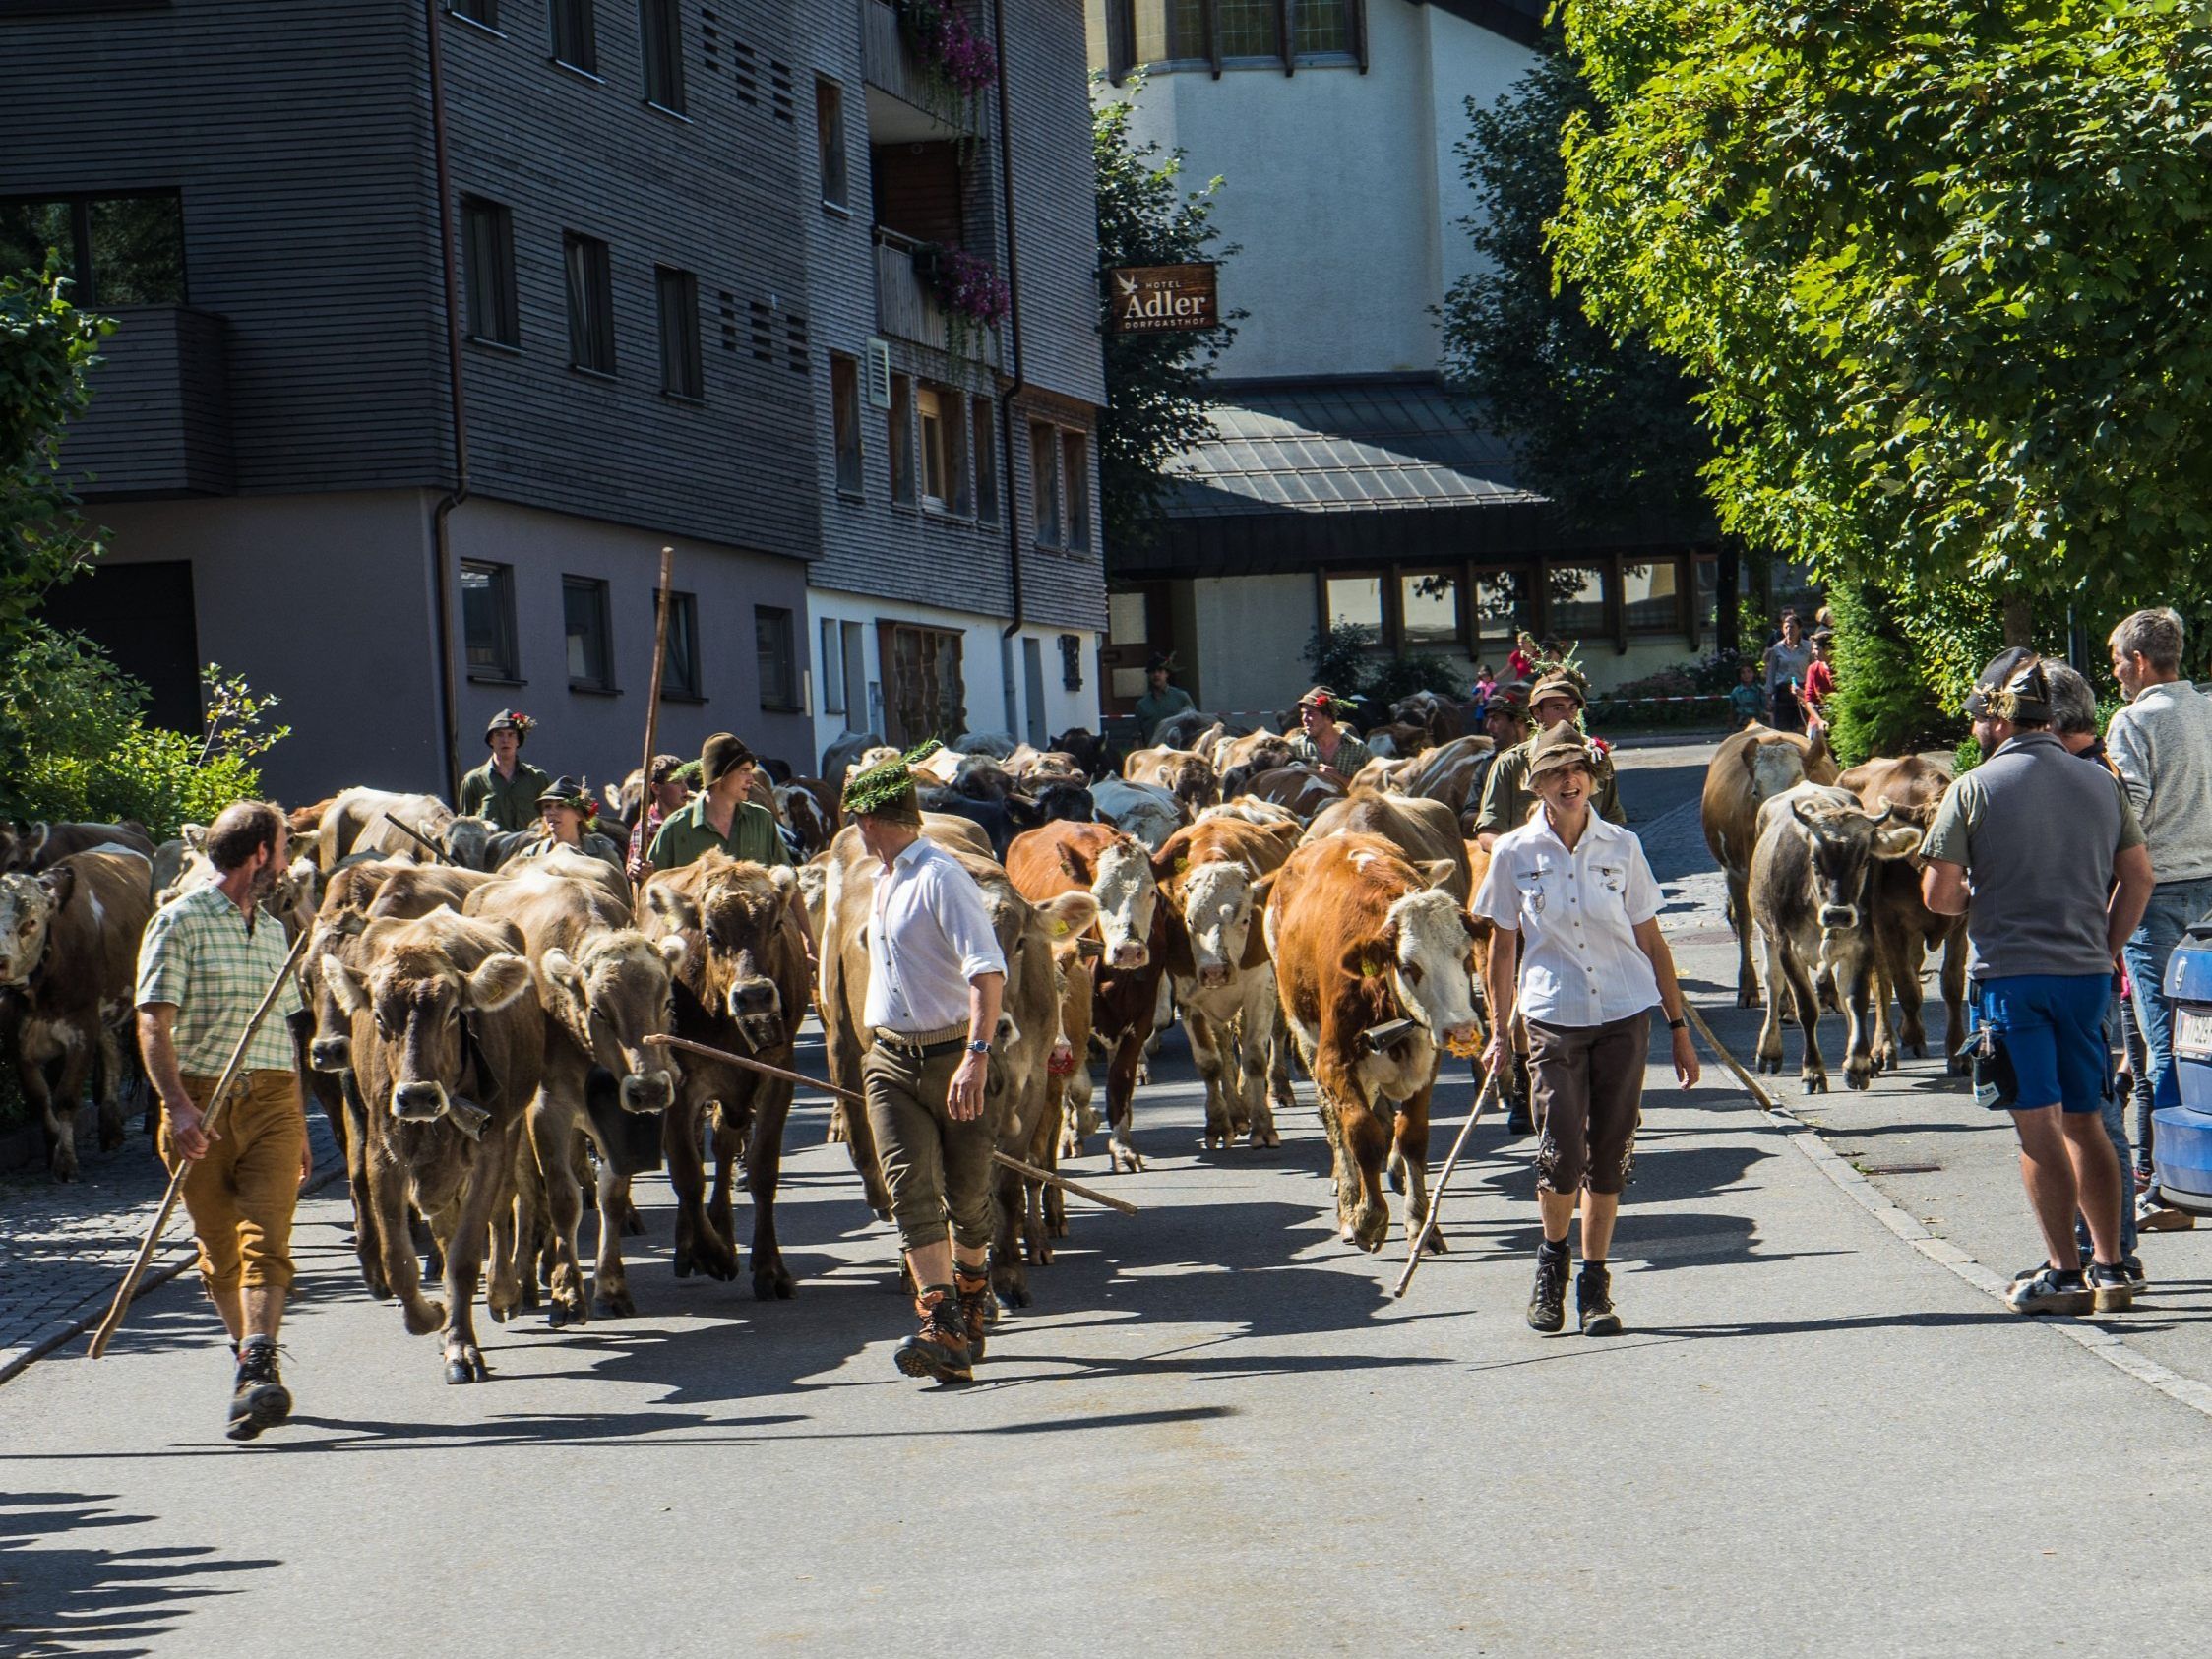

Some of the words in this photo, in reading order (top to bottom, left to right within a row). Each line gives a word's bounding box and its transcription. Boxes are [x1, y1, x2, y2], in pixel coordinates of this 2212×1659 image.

[1145, 280, 1182, 289] HOTEL
[1123, 291, 1207, 319] Adler
[1125, 317, 1206, 329] DORFGASTHOF
